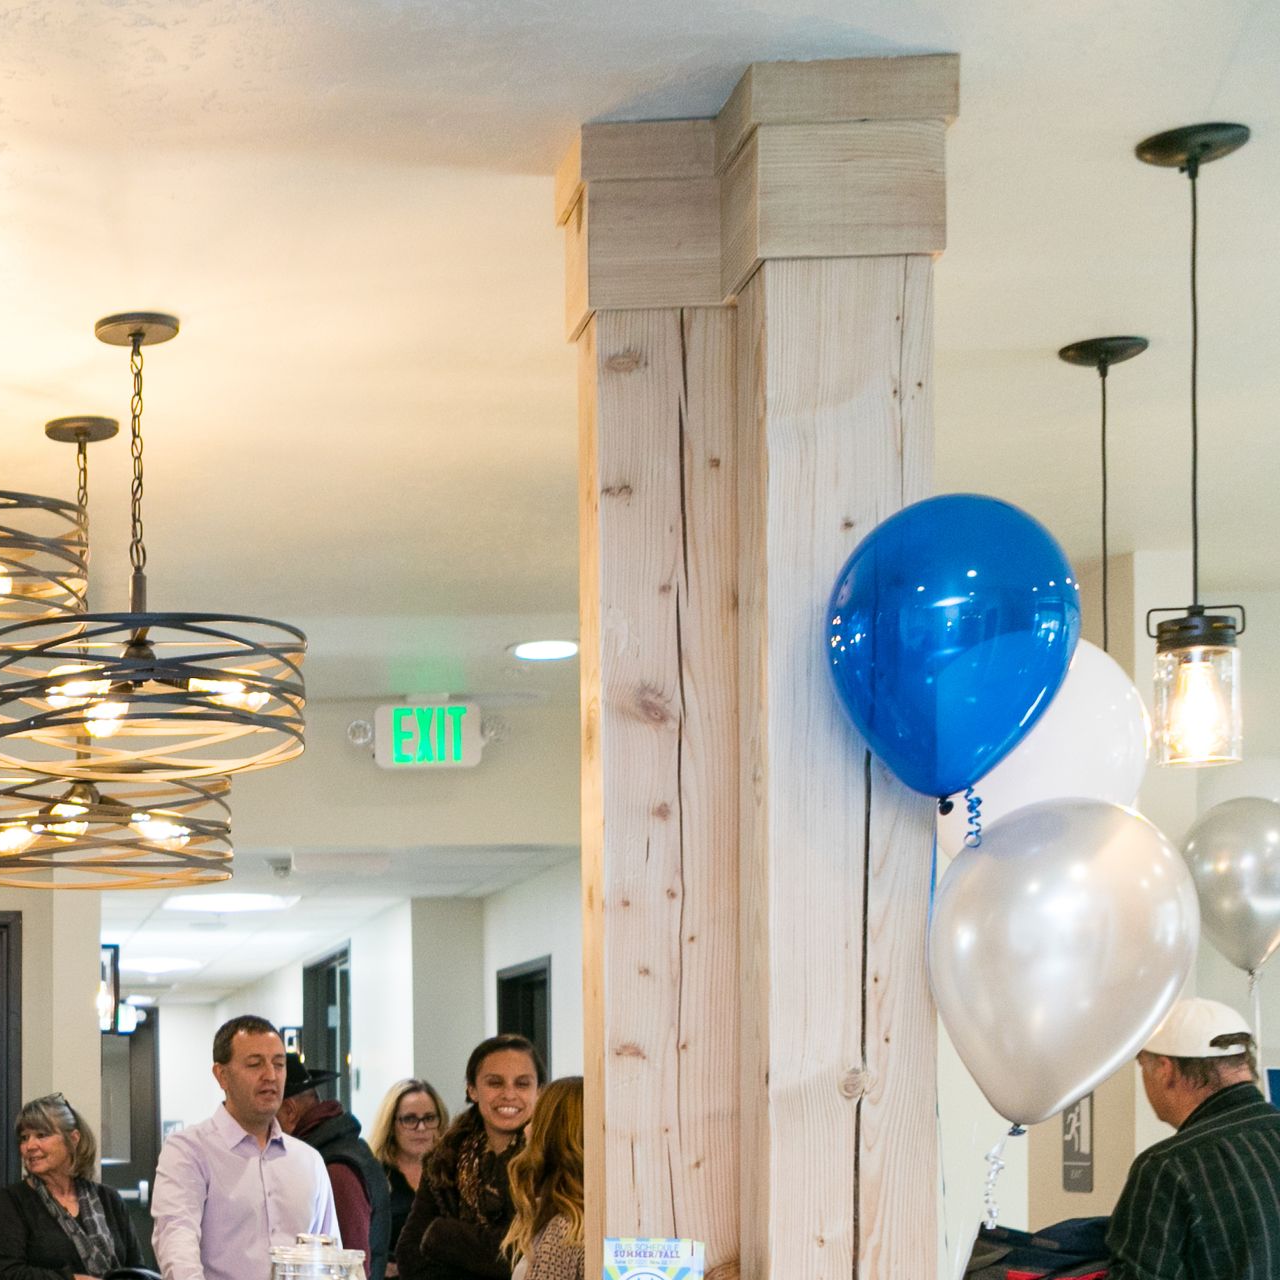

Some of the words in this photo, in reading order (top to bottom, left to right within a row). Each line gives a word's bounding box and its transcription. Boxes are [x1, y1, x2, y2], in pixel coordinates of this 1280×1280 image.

[392, 705, 467, 764] EXIT
[635, 1243, 679, 1251] SCHEDULE
[614, 1250, 681, 1259] SUMMER/FALL
